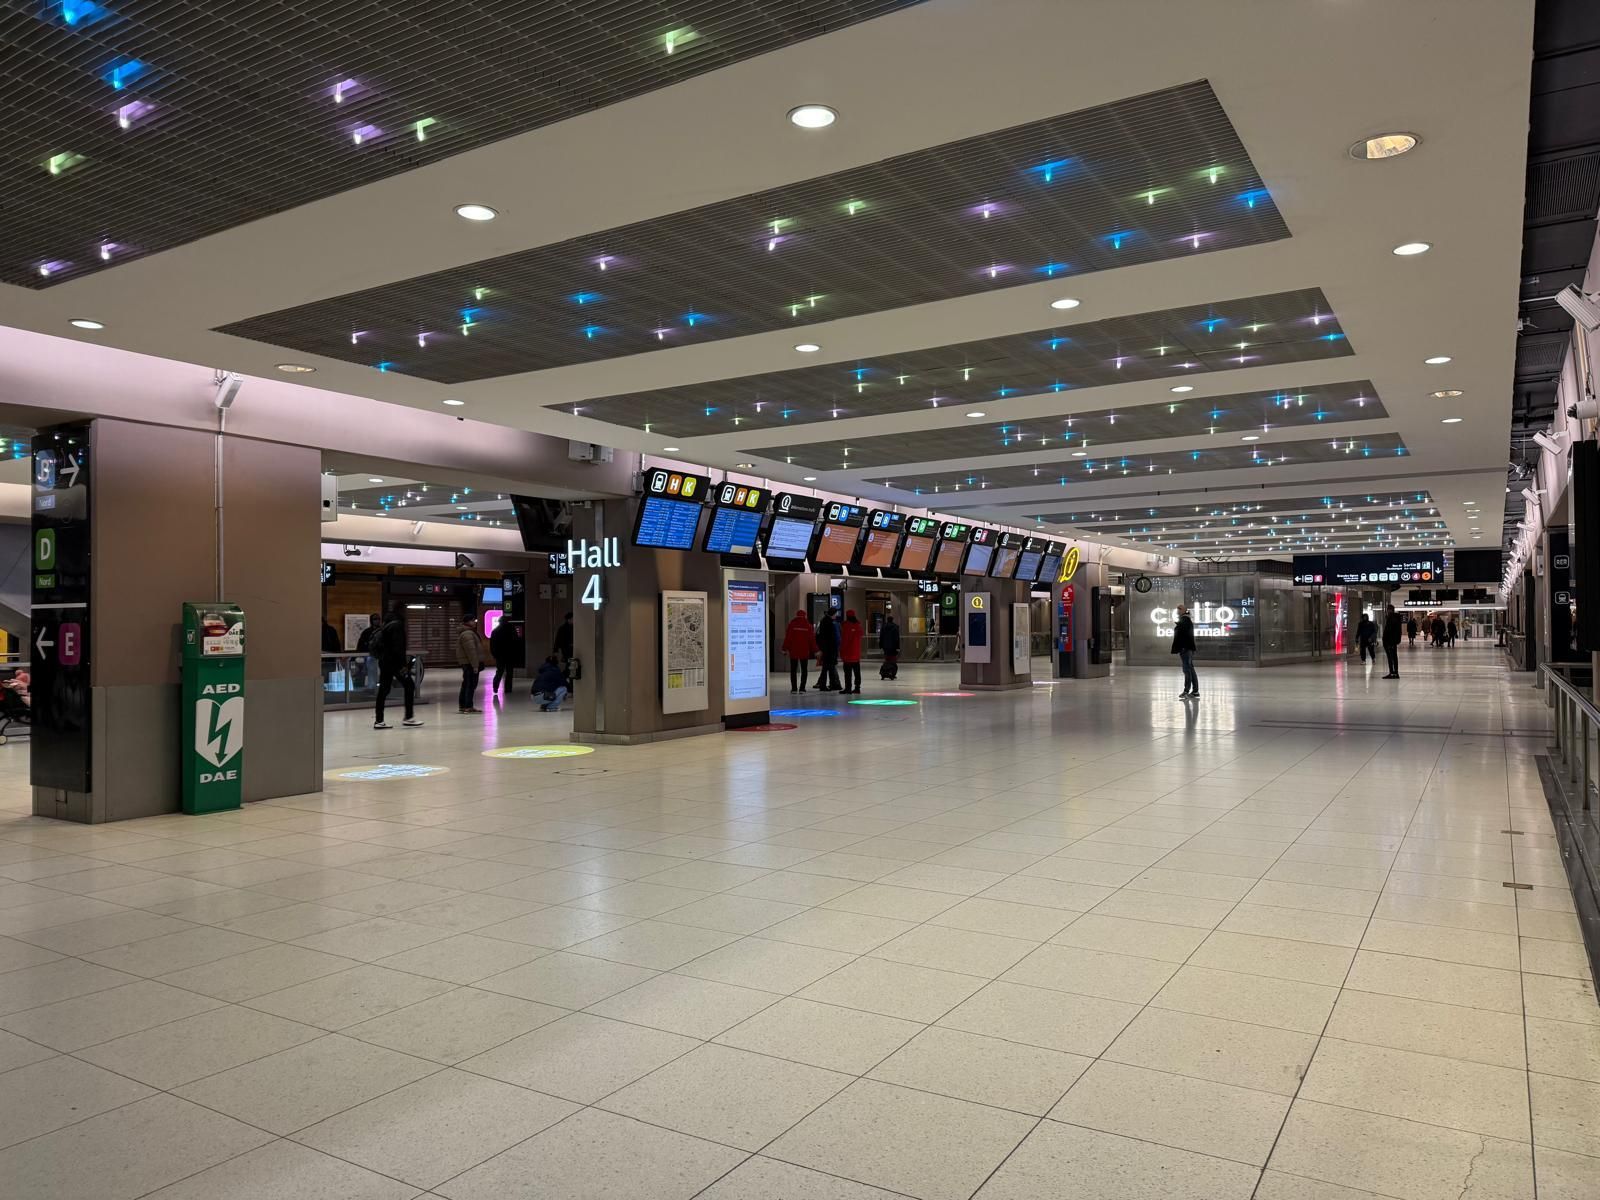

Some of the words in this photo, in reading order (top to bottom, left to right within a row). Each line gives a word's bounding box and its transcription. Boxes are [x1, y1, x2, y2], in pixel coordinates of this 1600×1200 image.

[40, 459, 50, 482] B
[670, 478, 680, 491] H
[685, 481, 694, 493] K
[737, 492, 746, 502] H
[749, 494, 758, 504] K
[841, 509, 847, 518] B
[40, 538, 51, 561] D
[567, 537, 621, 568] Hall
[39, 577, 51, 587] Nord
[581, 574, 603, 611] 4
[831, 598, 839, 606] B
[945, 596, 953, 605] D
[65, 632, 74, 656] E
[202, 683, 241, 695] AED
[199, 769, 238, 784] DAE
